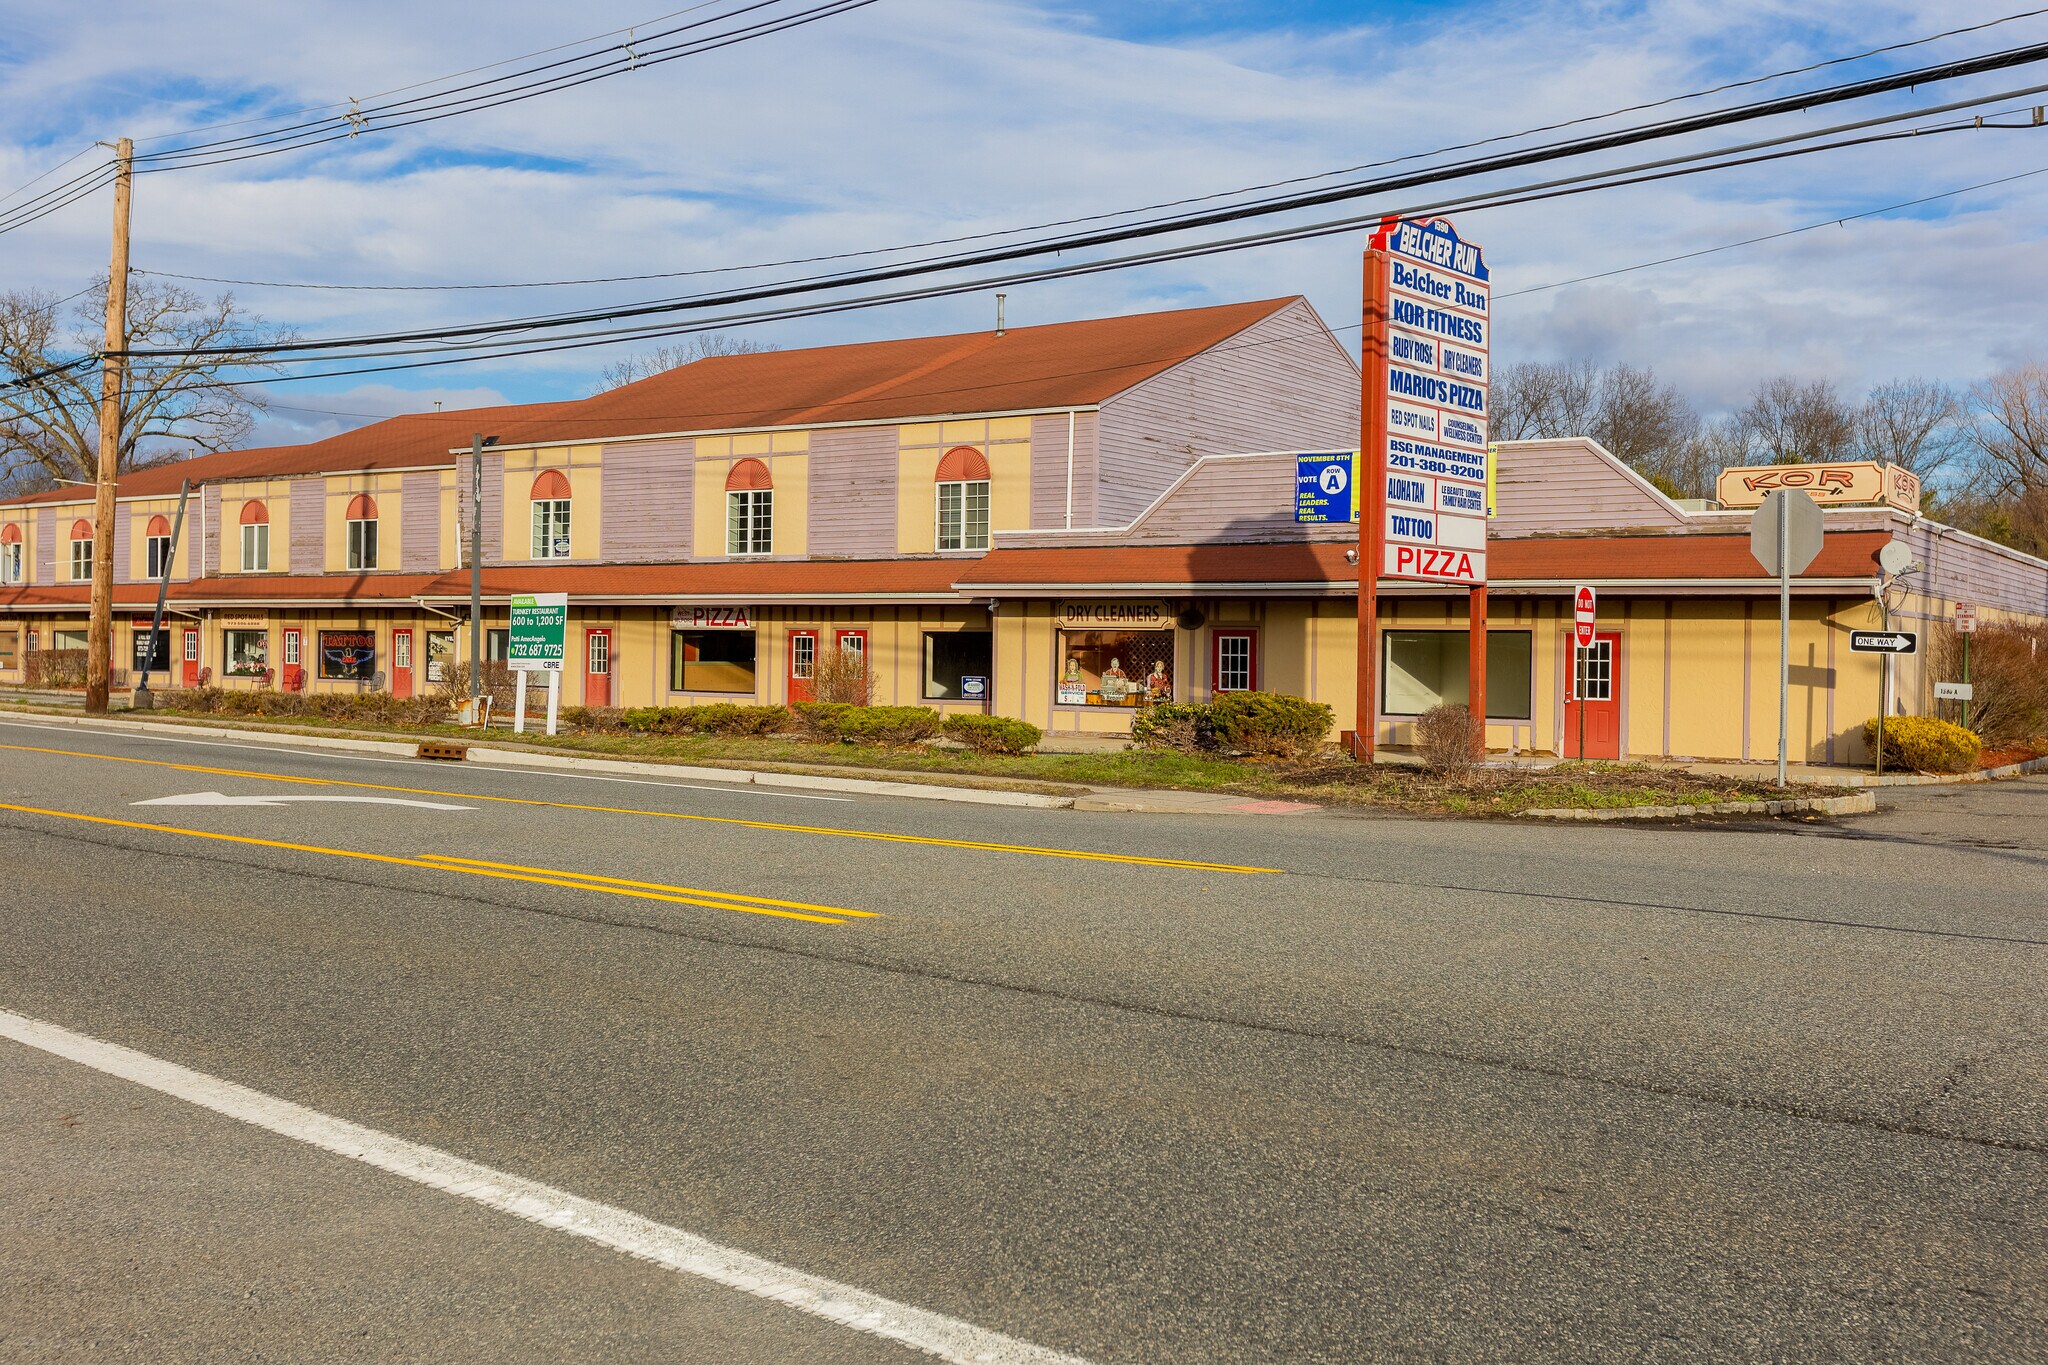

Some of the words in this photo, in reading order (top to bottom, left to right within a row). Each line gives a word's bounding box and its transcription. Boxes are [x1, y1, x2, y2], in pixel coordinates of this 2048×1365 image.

[1434, 221, 1449, 234] 1590
[1399, 223, 1453, 267] BELCHER
[1454, 244, 1478, 275] RUN
[1393, 261, 1451, 300] Belcher
[1455, 282, 1486, 311] Run
[1393, 299, 1425, 328] KOR
[1427, 308, 1482, 343] FITNESS
[1393, 336, 1414, 361] RUBY
[1414, 340, 1433, 365] ROSE
[1444, 349, 1455, 371] DRY
[1456, 352, 1482, 377] CLEANERS
[1390, 369, 1447, 403] MARIO'S
[1450, 383, 1483, 411] PIZZA
[1391, 409, 1402, 424] RED
[1403, 411, 1418, 428] SPOT
[1419, 415, 1435, 432] NAILS
[1444, 426, 1466, 442] WELLNESS
[1466, 430, 1482, 444] CENTER
[1390, 440, 1413, 454] BSG
[1415, 444, 1484, 466] MANAGEMENT
[1390, 453, 1484, 480] 201-380-9200
[1326, 475, 1340, 490] A
[1388, 478, 1411, 501] ALOHA
[1411, 481, 1425, 503] TAN
[1743, 470, 1854, 491] KOR
[1894, 474, 1915, 498] KOR
[1442, 485, 1447, 494] LE
[1466, 490, 1482, 499] LOUNGE
[1443, 495, 1457, 506] FAMILY
[1457, 497, 1467, 508] HAIR
[1467, 499, 1482, 511] CENTER
[1392, 515, 1432, 539] TATTOO
[1397, 547, 1474, 579] PIZZA
[1067, 605, 1091, 622] DRY
[1095, 605, 1160, 622] CLEANERS
[1578, 599, 1583, 608] DO
[512, 617, 526, 625] 600
[527, 617, 533, 625] to
[536, 616, 554, 626] 1,200
[555, 616, 563, 625] SF
[694, 607, 748, 626] PIZZA
[324, 635, 375, 647] TATTOO
[1579, 625, 1590, 635] ENTER
[514, 644, 527, 656] 732
[529, 644, 542, 656] 687
[544, 644, 562, 656] 9725
